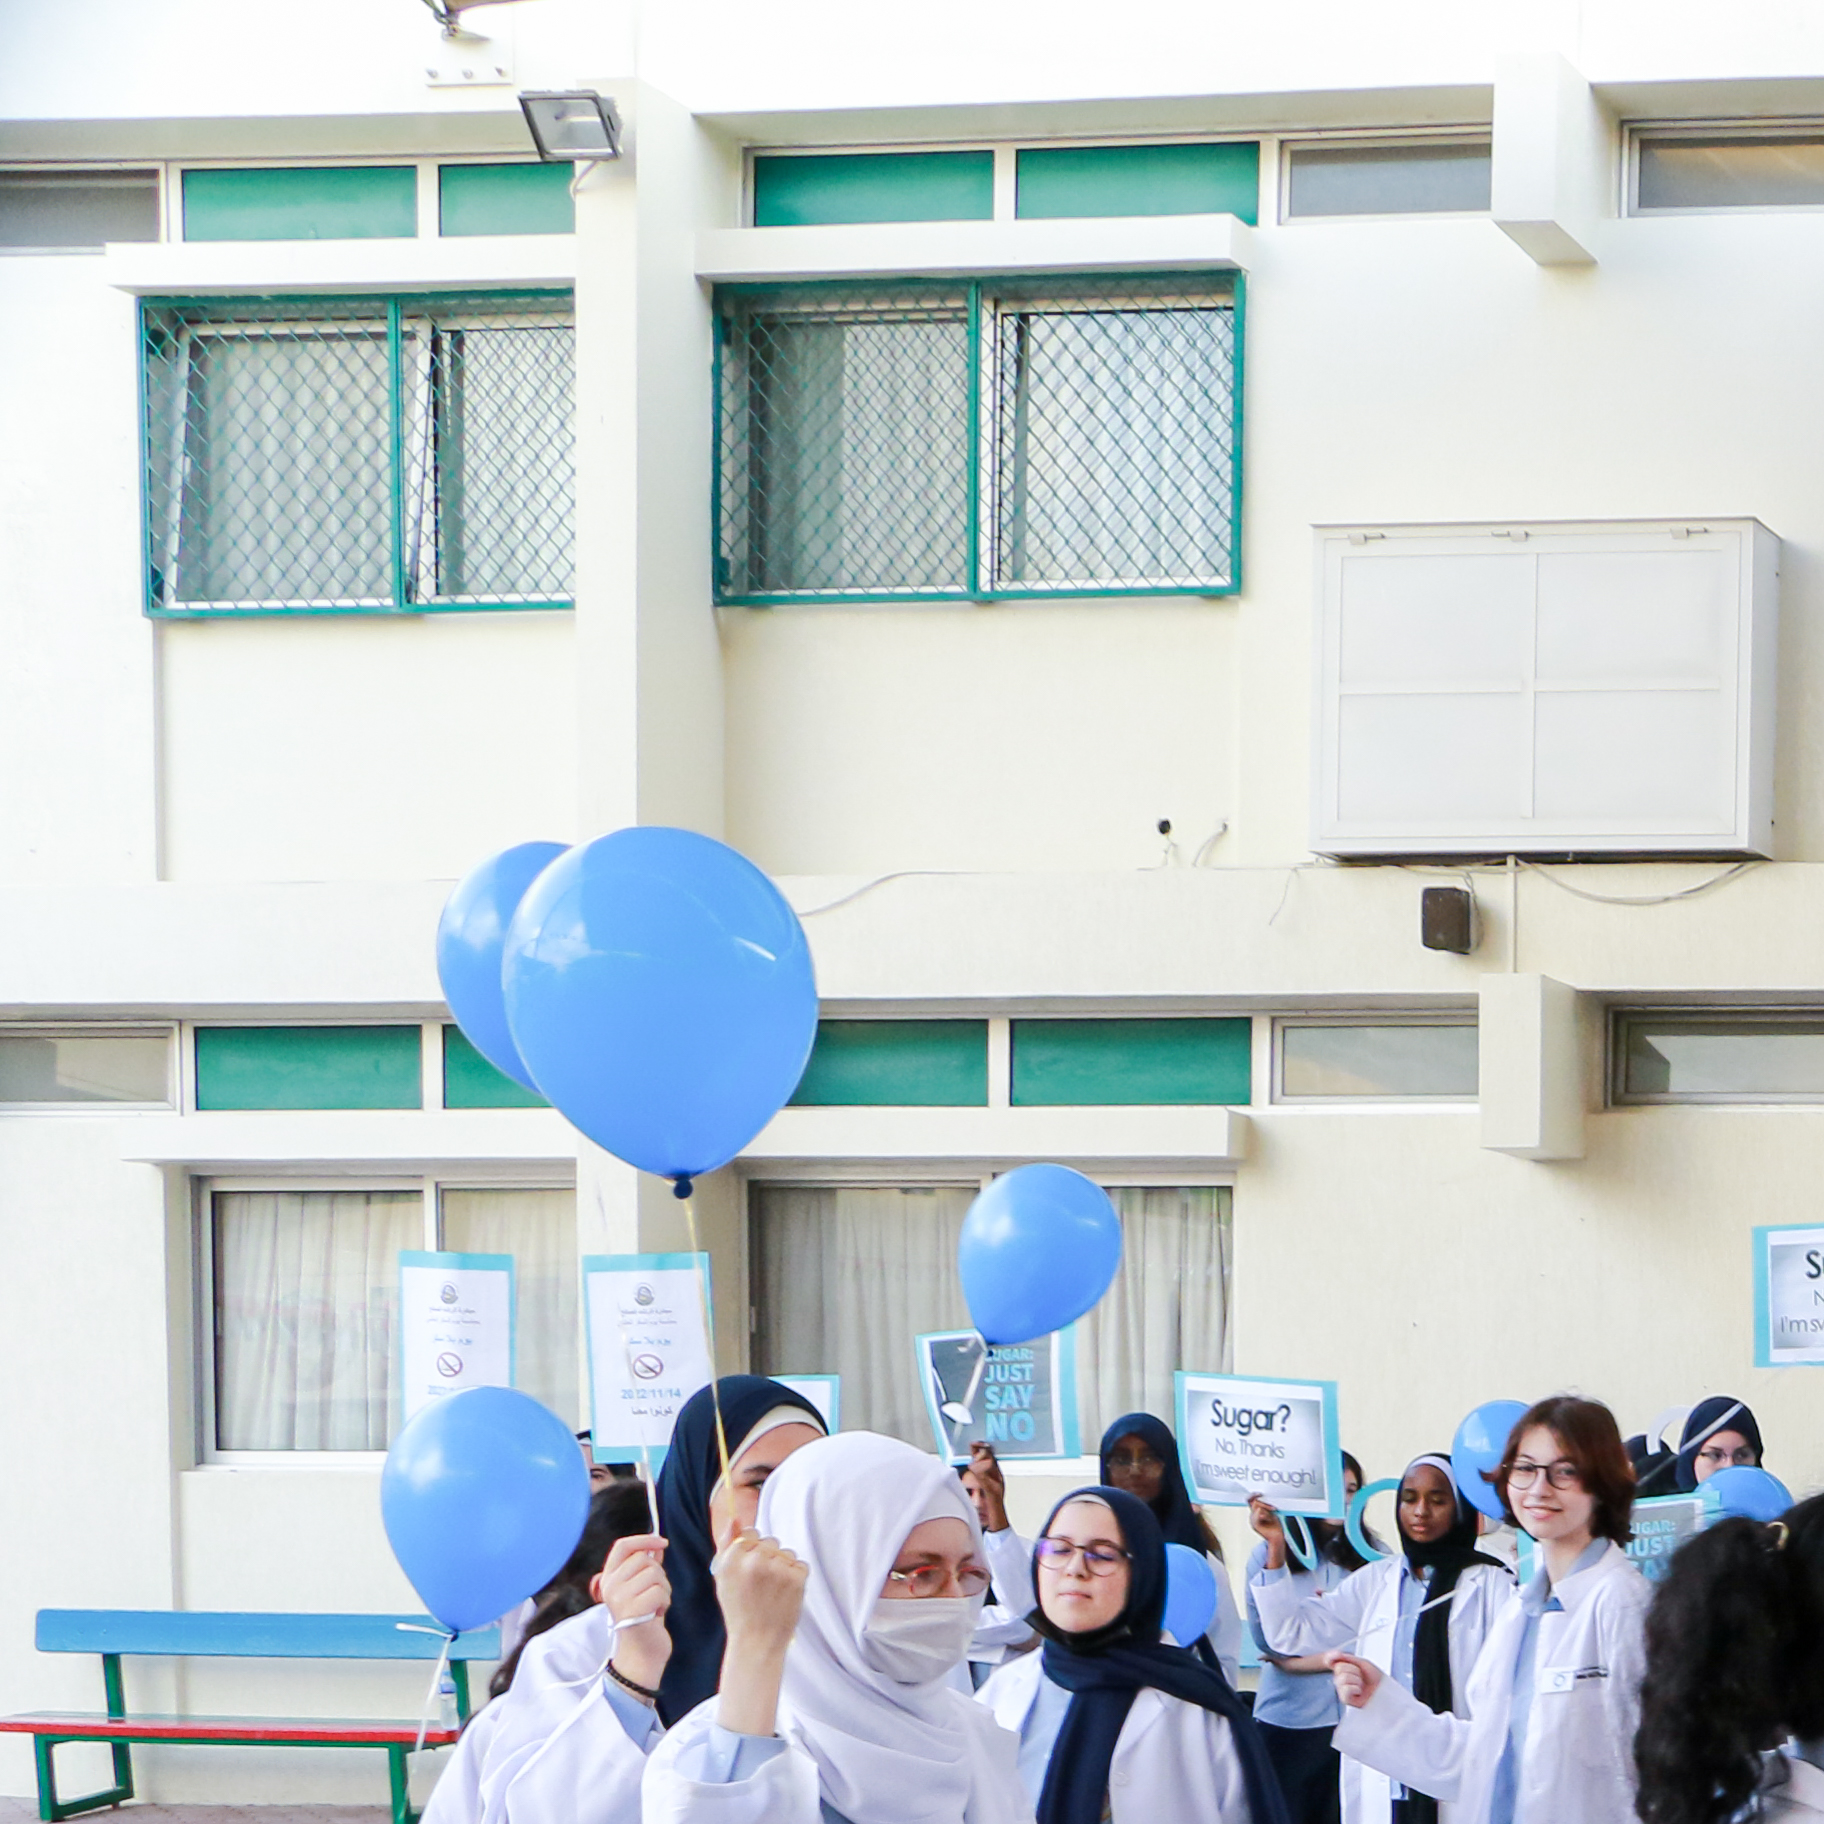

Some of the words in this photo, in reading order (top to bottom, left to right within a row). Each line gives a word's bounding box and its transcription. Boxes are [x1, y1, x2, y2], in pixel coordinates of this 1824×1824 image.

[1781, 1316, 1808, 1333] I'm
[984, 1363, 1034, 1383] JUST
[984, 1384, 1035, 1410] SAY
[985, 1411, 1035, 1442] NO
[1211, 1398, 1291, 1436] Sugar?
[1215, 1437, 1236, 1456] No,
[1239, 1439, 1285, 1459] Thanks
[1214, 1464, 1249, 1481] sweet
[1251, 1467, 1317, 1489] enough!
[1630, 1519, 1676, 1534] UGAR:
